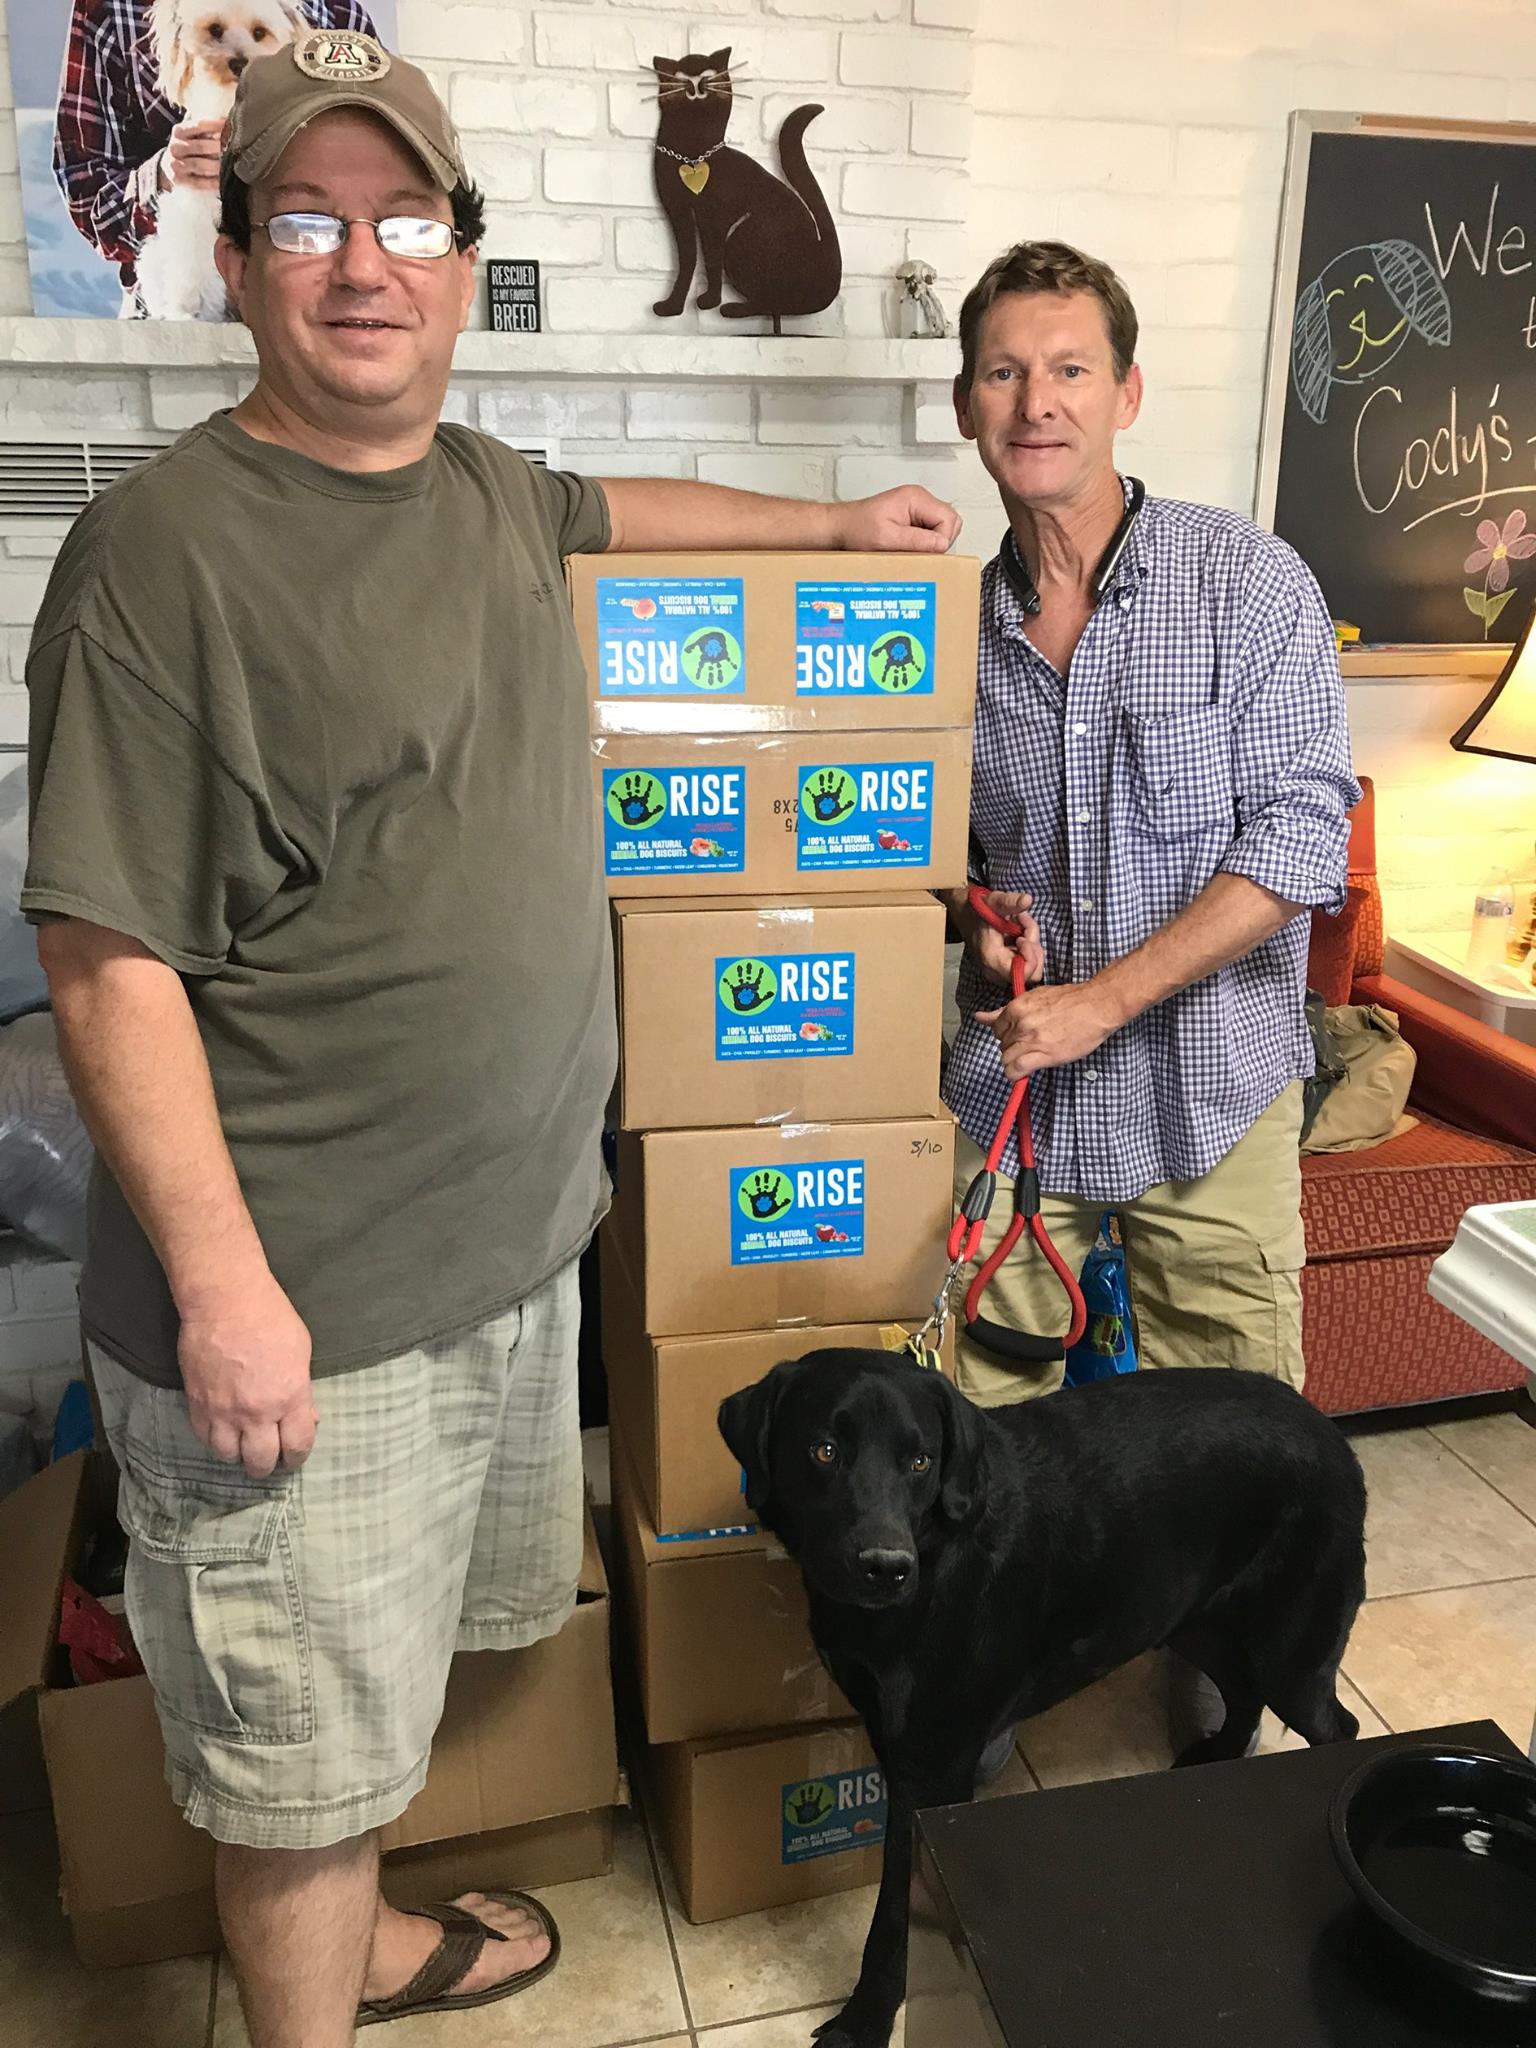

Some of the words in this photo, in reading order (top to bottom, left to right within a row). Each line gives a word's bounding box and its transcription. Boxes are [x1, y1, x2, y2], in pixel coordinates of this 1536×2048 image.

[325, 42, 363, 66] A
[491, 265, 536, 286] RESCUED
[492, 288, 499, 301] IS
[499, 288, 510, 301] MY
[509, 288, 536, 302] FAVORITE
[493, 303, 538, 332] BREED
[1354, 383, 1513, 516] Cody's
[659, 595, 692, 605] BISCUITS
[693, 595, 709, 605] DOG
[849, 600, 882, 610] BISCUITS
[663, 605, 697, 615] NATURAL
[697, 605, 711, 615] ALL
[712, 605, 733, 615] 100%
[854, 610, 886, 620] NATURAL
[887, 609, 900, 619] ALL
[900, 609, 921, 619] 100%
[605, 640, 679, 686] RISE
[796, 643, 865, 689] RISE
[670, 774, 740, 816] RISE
[861, 768, 928, 813] RISE
[616, 841, 636, 850] 100%
[637, 840, 651, 850] ALL
[651, 839, 684, 850] NATURAL
[807, 836, 826, 846] 100%
[827, 836, 840, 845] ALL
[841, 834, 871, 845] NATURAL
[639, 849, 654, 859] DOG
[655, 848, 688, 858] BISCUITS
[829, 844, 844, 854] DOG
[845, 843, 875, 854] BISCUITS
[780, 960, 849, 1002] RISE
[726, 1026, 746, 1036] 100%
[748, 1025, 761, 1035] ALL
[761, 1024, 793, 1034] NATURAL
[749, 1034, 764, 1044] DOG
[765, 1033, 797, 1043] BISCUITS
[797, 1166, 864, 1209] RISE
[745, 1232, 765, 1242] 100%
[766, 1231, 778, 1240] ALL
[779, 1228, 809, 1239] NATURAL
[767, 1239, 782, 1249] DOG
[782, 1236, 813, 1247] BISCUITS
